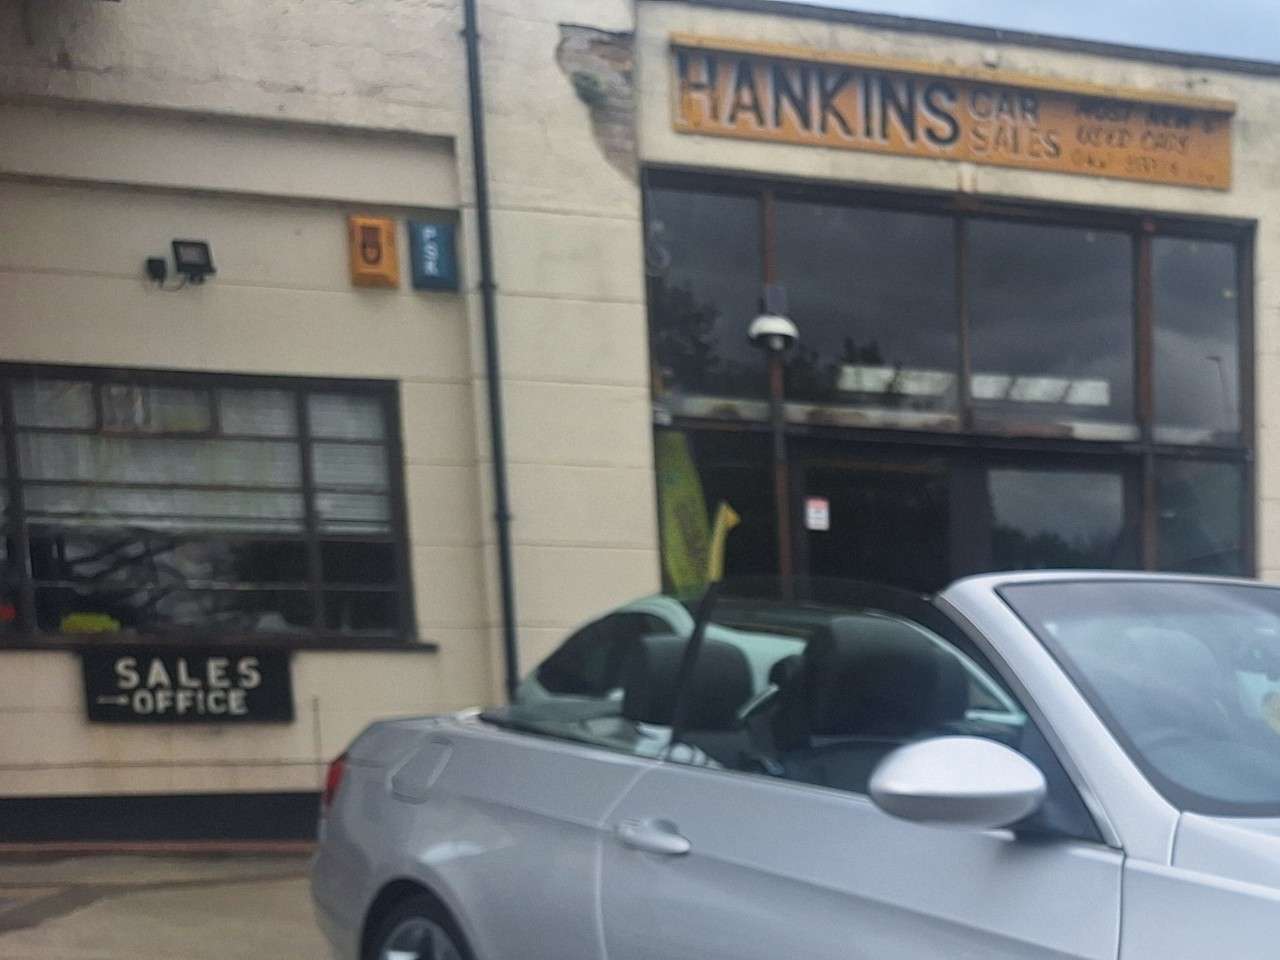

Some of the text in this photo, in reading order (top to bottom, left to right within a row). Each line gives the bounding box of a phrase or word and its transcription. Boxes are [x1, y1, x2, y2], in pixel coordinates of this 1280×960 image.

[675, 50, 960, 147] HANKINS
[968, 86, 1042, 126] CAR
[968, 123, 1062, 161] SALES
[114, 656, 262, 690] SALES
[131, 688, 249, 716] OFFICE
